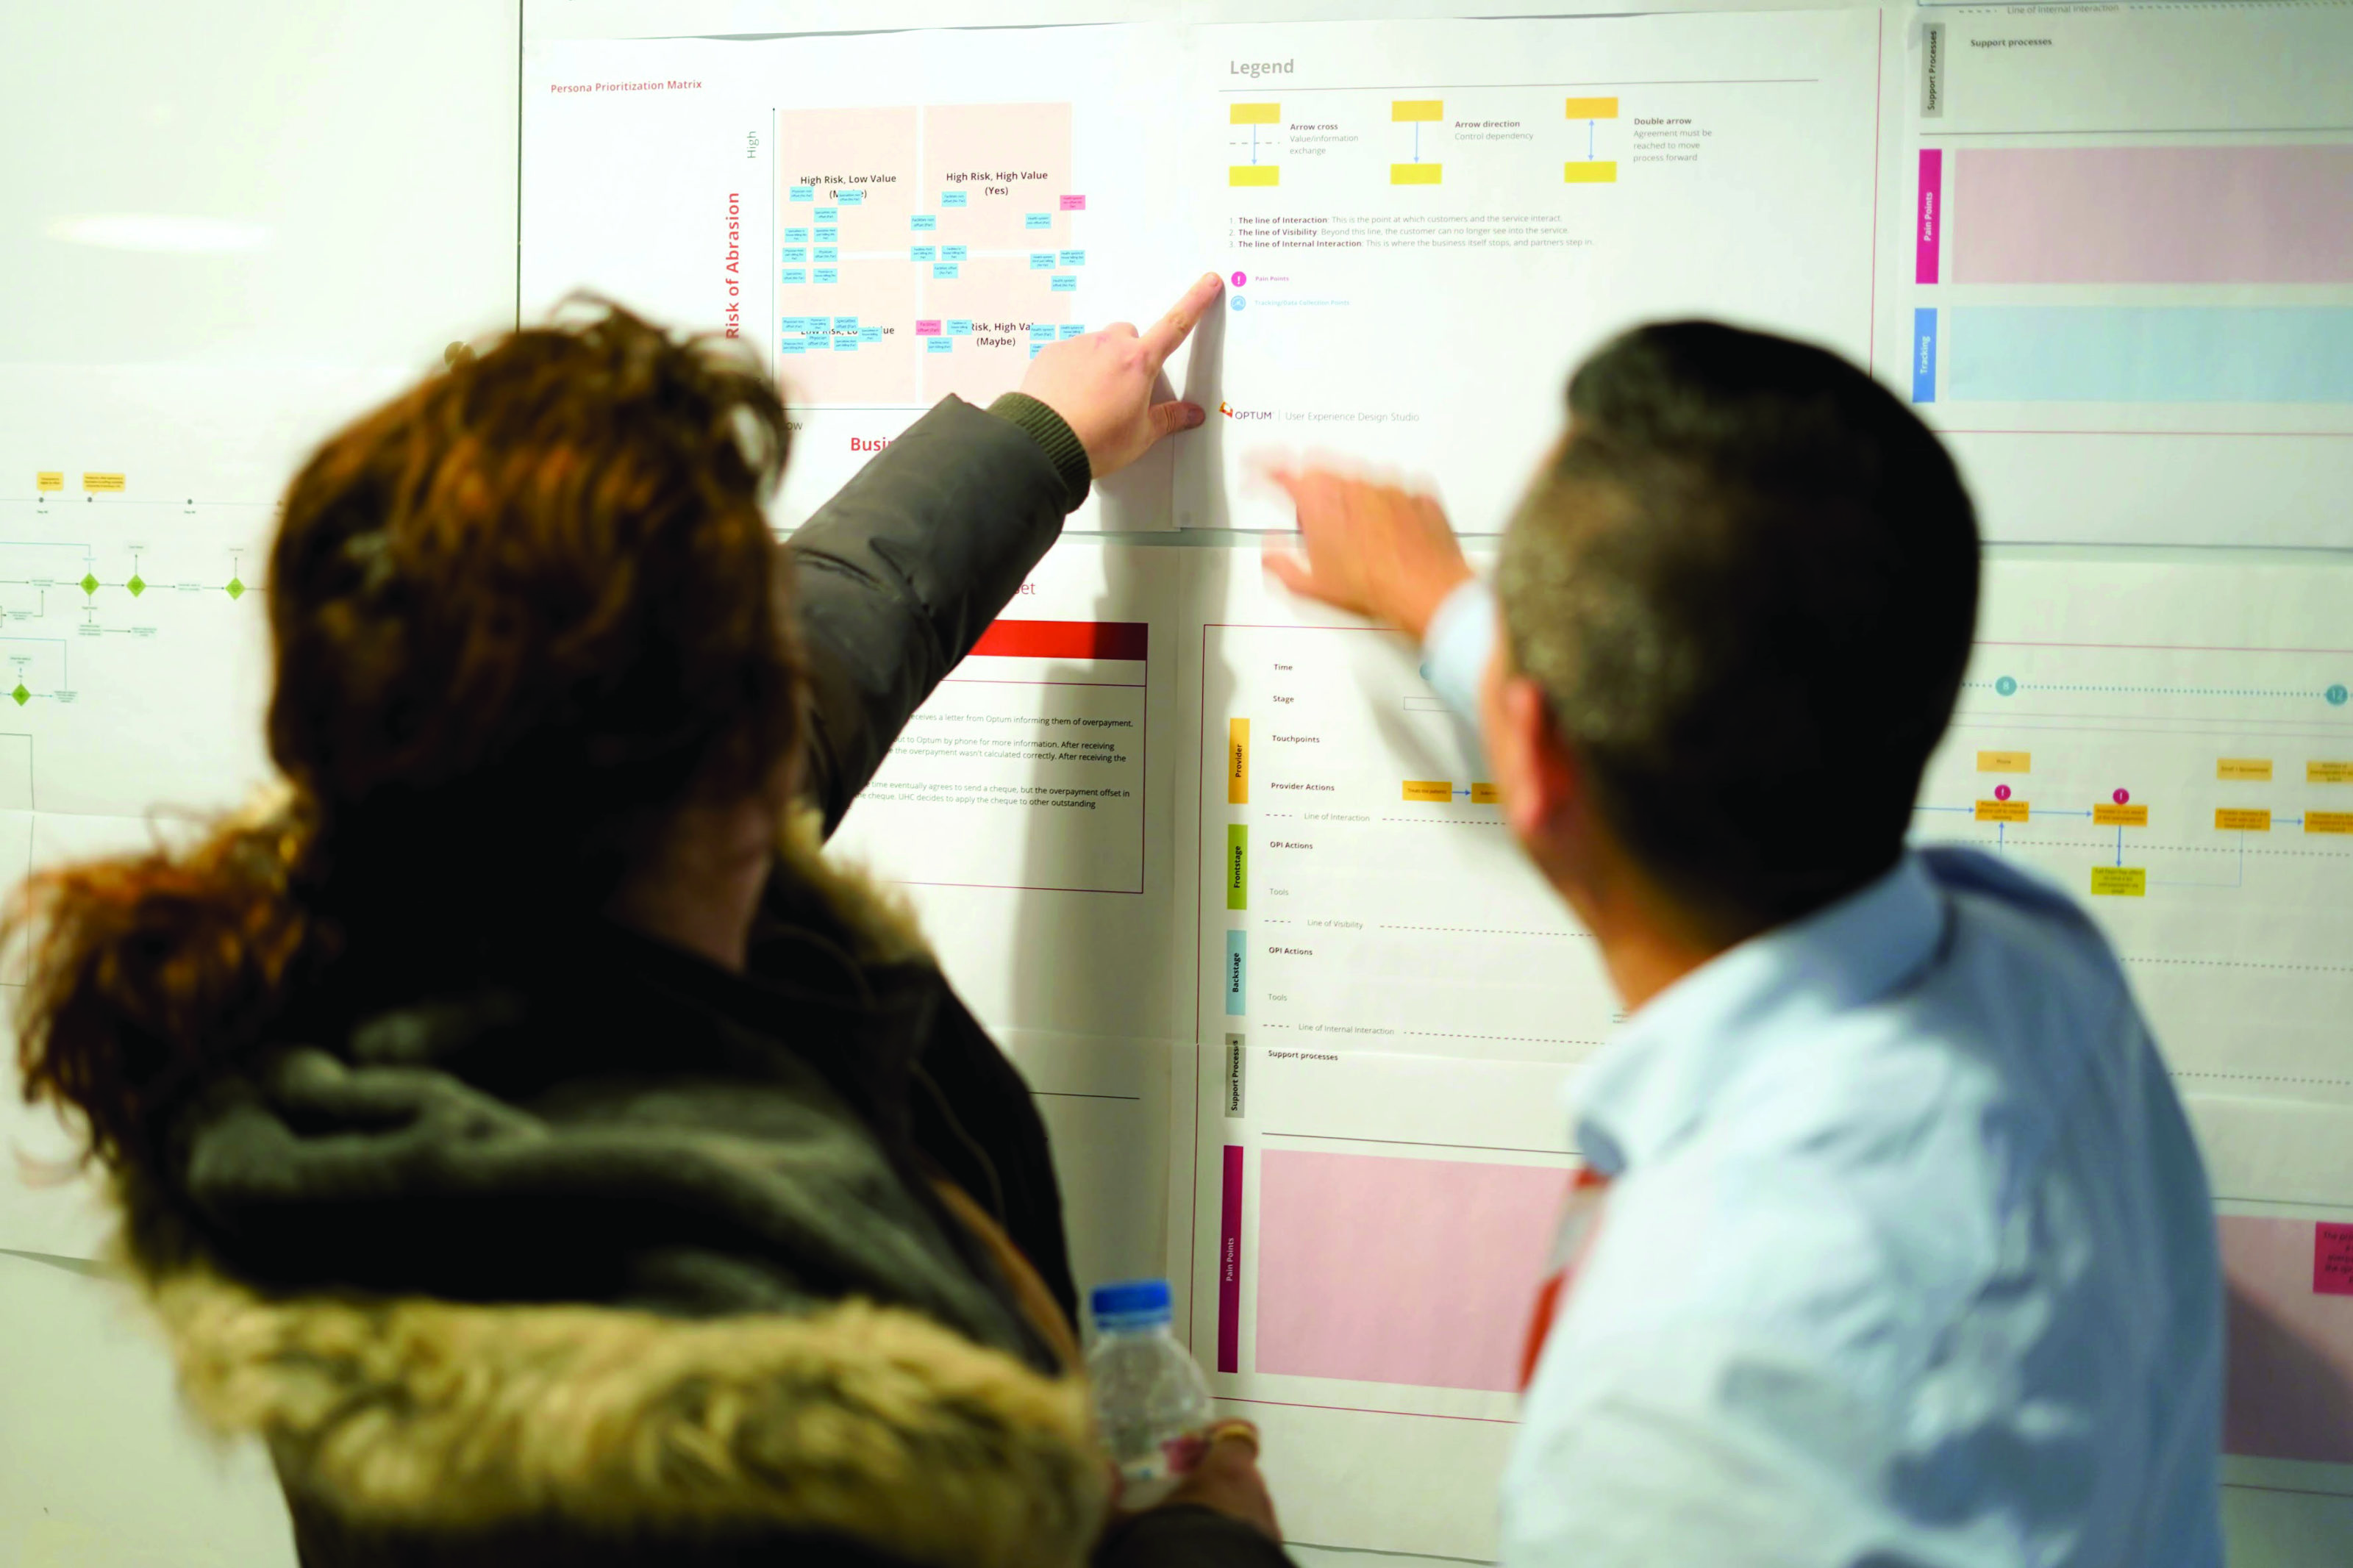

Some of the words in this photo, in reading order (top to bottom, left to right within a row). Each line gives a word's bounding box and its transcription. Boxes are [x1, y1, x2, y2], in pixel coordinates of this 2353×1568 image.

[2007, 6, 2024, 15] Line
[2038, 5, 2071, 13] Internal
[2073, 4, 2119, 12] Interaction
[1971, 39, 2006, 47] Support
[2007, 39, 2052, 47] processes
[1928, 29, 1936, 73] Processes
[1229, 58, 1294, 78] Legend
[550, 84, 592, 93] Persona
[595, 81, 664, 91] Prioritization
[667, 80, 701, 88] Matrix
[1927, 76, 1936, 110] Support
[1485, 132, 1534, 141] dependency
[1634, 130, 1679, 138] Agreement
[746, 131, 759, 158] High
[1289, 147, 1327, 156] exchange
[800, 176, 821, 187] High
[824, 175, 846, 184] Risk,
[849, 175, 868, 183] Low
[870, 174, 896, 182] Value
[946, 172, 968, 182] High
[970, 172, 993, 181] Risk,
[996, 171, 1018, 182] High
[1020, 171, 1048, 179] Value
[985, 187, 1008, 196] (Yes)
[1924, 192, 1932, 220] Points
[725, 193, 738, 273] Abrasion
[1282, 229, 1318, 237] Visibility:
[1924, 222, 1932, 241] Pain
[725, 278, 738, 296] of
[725, 302, 738, 339] Risk
[994, 322, 1016, 334] High
[976, 337, 1015, 347] (Maybe)
[1919, 335, 1930, 373] Tracking
[1235, 411, 1273, 419] OPTUM
[1285, 412, 1304, 420] User
[1307, 412, 1355, 422] Experience
[1357, 412, 1388, 423] Design
[1388, 412, 1421, 421] Studio
[785, 422, 803, 430] ow
[2003, 681, 2010, 690] 8
[1273, 695, 1294, 704] Stage
[2332, 687, 2343, 700] 12
[985, 715, 1012, 723] Optum
[1013, 716, 1050, 726] informing
[1050, 717, 1071, 725] them
[1082, 720, 1134, 728] overpayment.
[1272, 734, 1320, 743] Touchpoints
[908, 748, 957, 756] overpayment
[1022, 752, 1057, 761] correctly.
[1078, 753, 1113, 763] receiving
[888, 782, 927, 791] eventually
[928, 784, 953, 792] agrees
[988, 785, 1018, 793] cheque,
[1049, 788, 1099, 797] overpayment
[1099, 788, 1121, 797] offset
[1329, 813, 1371, 821] Interaction
[1234, 846, 1243, 888] Frontstage
[1332, 920, 1364, 929] Visibility
[1232, 952, 1240, 992] Backstage
[1324, 1025, 1353, 1033] Internal
[1268, 1050, 1299, 1059] Support
[1231, 1079, 1240, 1111] Support
[1226, 1264, 1234, 1281] Pain
